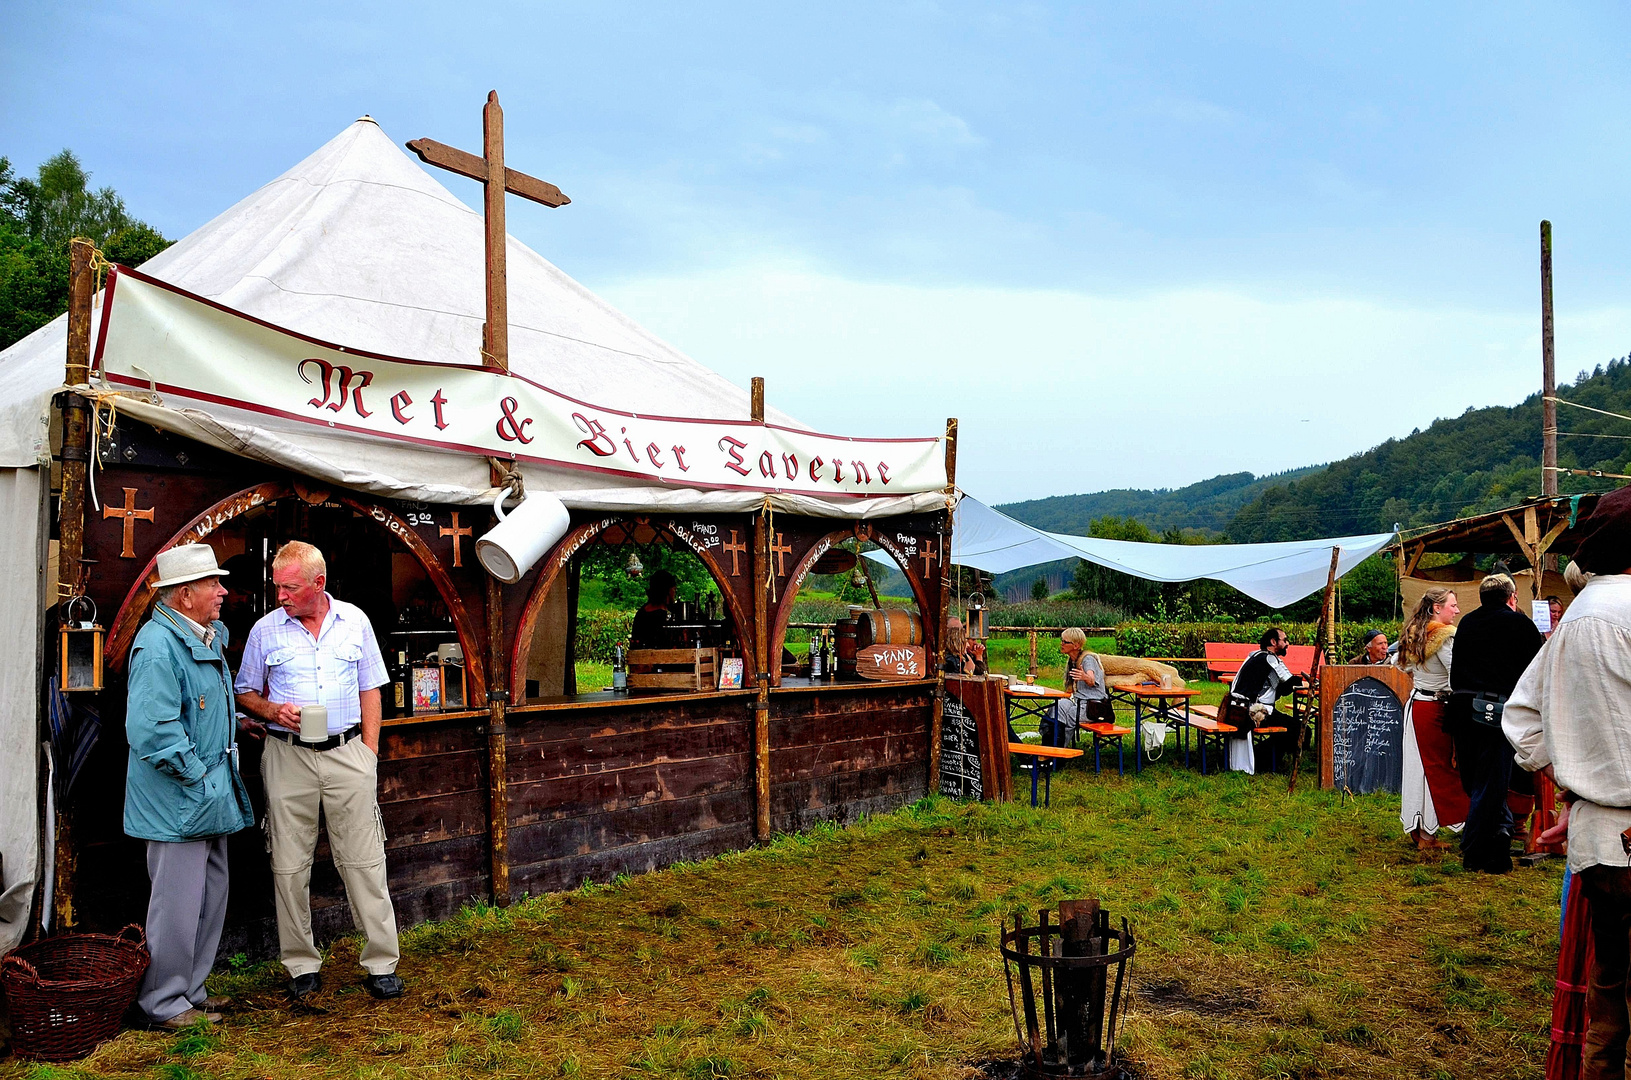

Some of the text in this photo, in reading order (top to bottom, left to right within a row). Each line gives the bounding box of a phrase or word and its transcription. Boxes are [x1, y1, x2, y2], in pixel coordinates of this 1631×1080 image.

[298, 356, 892, 486] Met & Bier Taverne
[692, 520, 718, 535] PFAND
[896, 532, 917, 545] PFAND
[873, 648, 915, 667] PFAND
